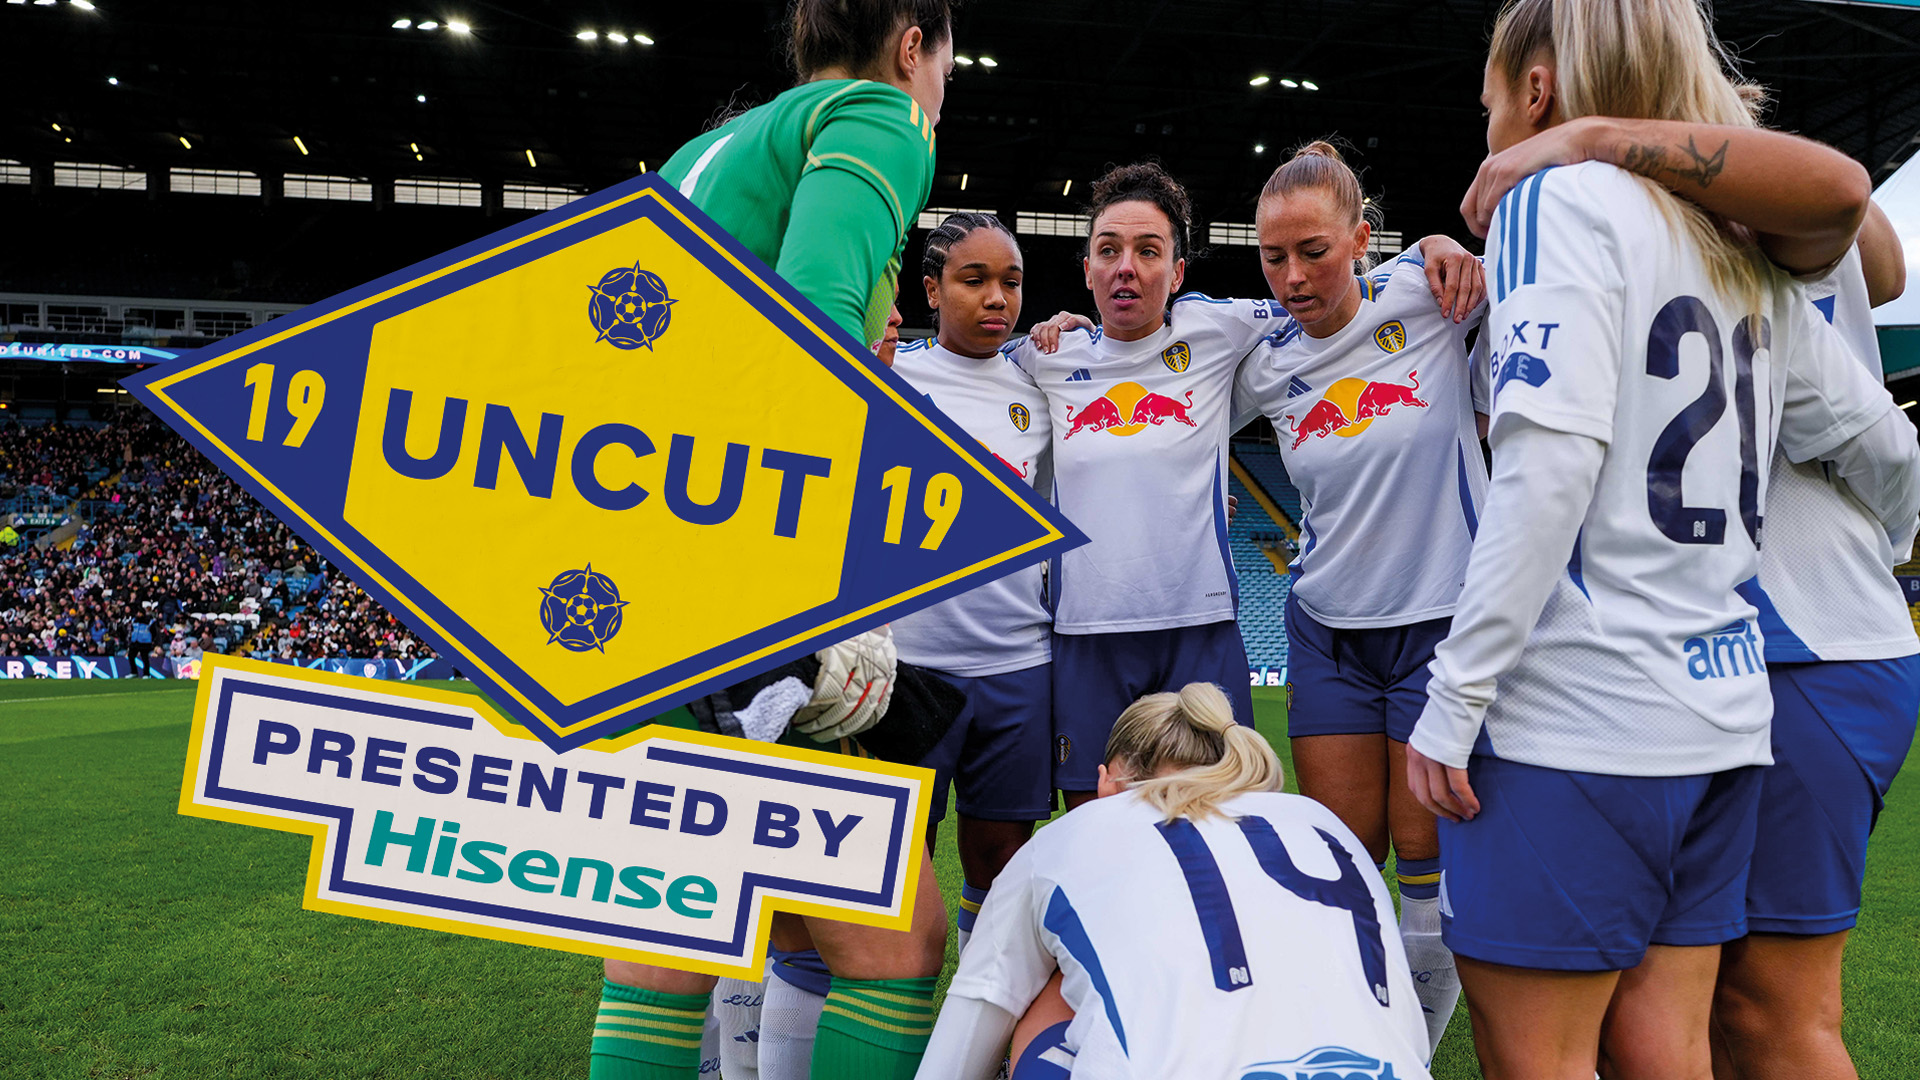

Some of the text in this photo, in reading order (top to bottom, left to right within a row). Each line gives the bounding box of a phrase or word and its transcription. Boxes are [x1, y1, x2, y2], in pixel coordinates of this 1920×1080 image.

[1646, 295, 1774, 551] 20
[7, 661, 98, 679] RSEY
[1684, 623, 1766, 681] amt
[1153, 815, 1390, 1008] 14
